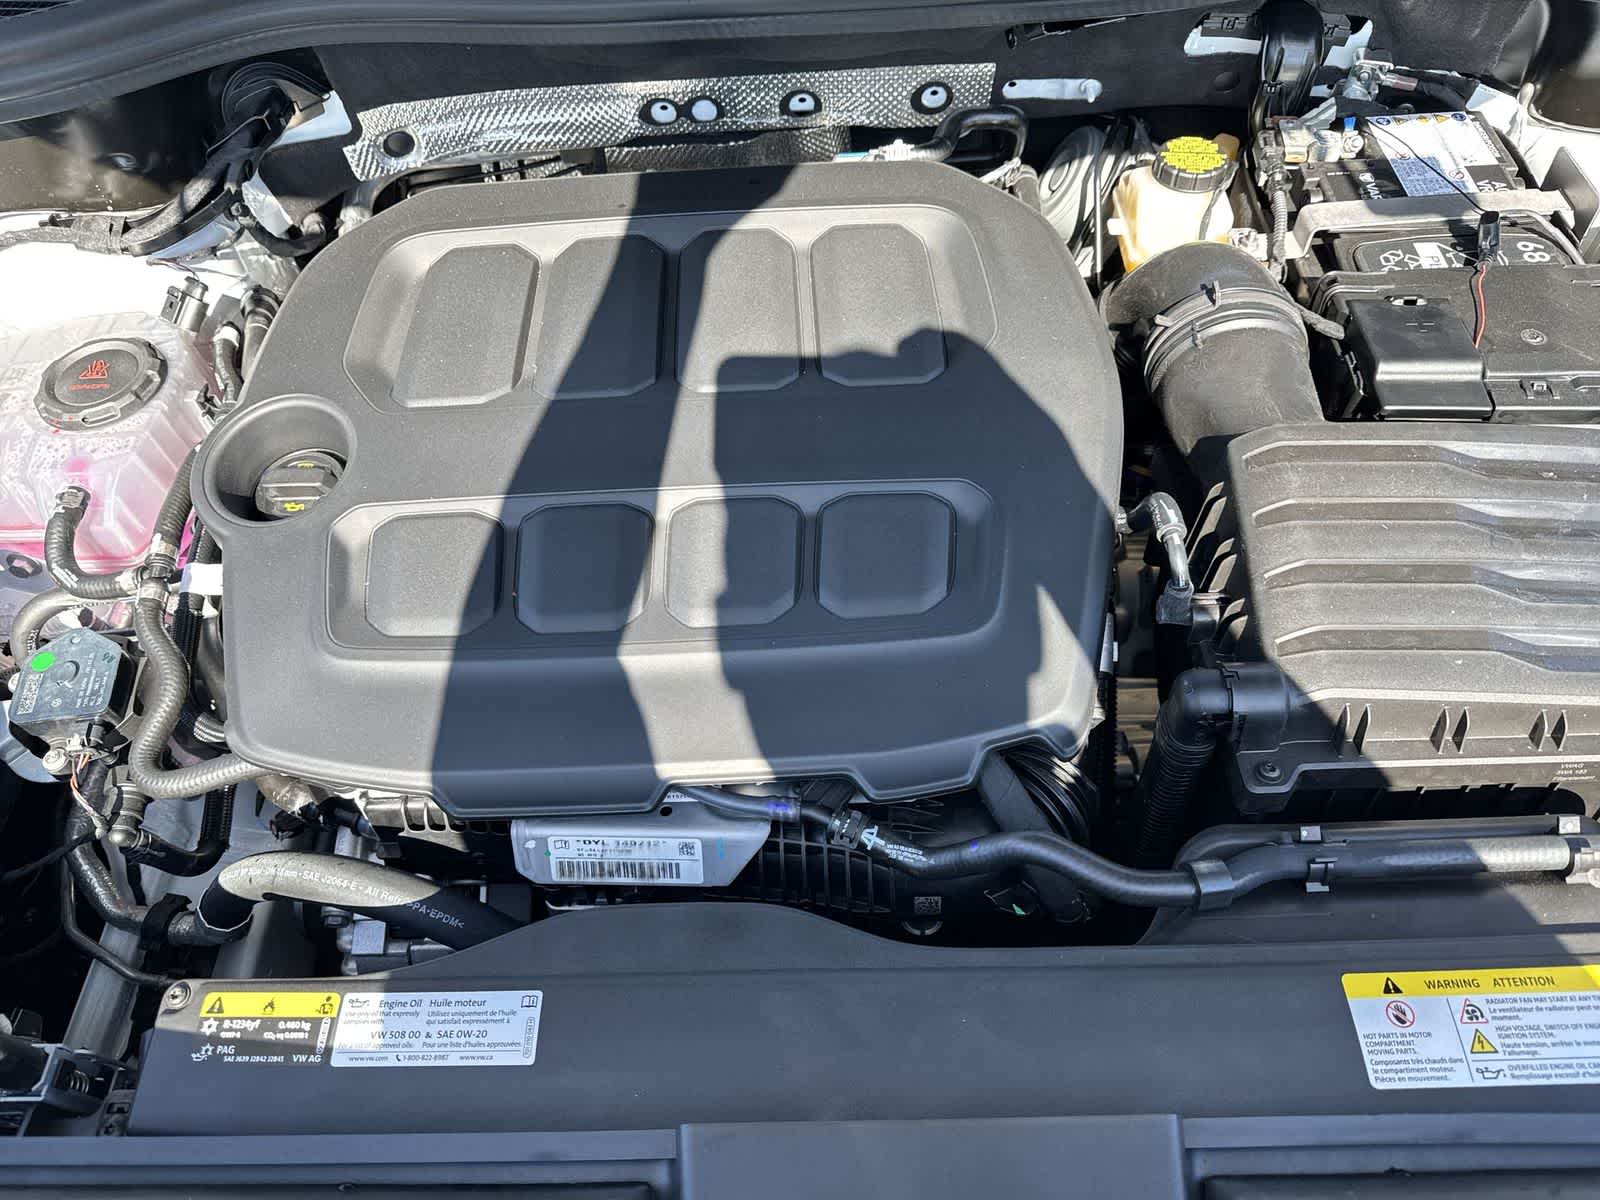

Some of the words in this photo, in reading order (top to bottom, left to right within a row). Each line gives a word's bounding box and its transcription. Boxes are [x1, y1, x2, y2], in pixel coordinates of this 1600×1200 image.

[1424, 978, 1480, 990] WARNING
[1493, 975, 1556, 988] ATTENTION
[379, 999, 408, 1010] Engine
[409, 999, 423, 1008] Oil
[430, 999, 453, 1008] Huile
[454, 999, 487, 1008] moteur
[1485, 997, 1518, 1005] RADIATOR
[1519, 996, 1533, 1004] FAN
[1547, 995, 1568, 1003] START
[1488, 1006, 1498, 1014] Le
[1499, 1005, 1534, 1013] ventilateur
[1535, 1004, 1544, 1012] de
[426, 1018, 437, 1026] qui
[370, 1030, 387, 1039] VW
[388, 1030, 406, 1040] 508
[408, 1030, 421, 1039] 00
[424, 1031, 432, 1039] &
[436, 1029, 455, 1039] SAE
[456, 1029, 488, 1039] 0W-20
[1377, 1032, 1399, 1040] PARTS
[1408, 1031, 1432, 1039] MOTOR
[422, 1041, 436, 1049] Pour
[216, 1045, 236, 1055] PAG
[1367, 1048, 1395, 1056] MOVING
[292, 1054, 308, 1063] VW
[308, 1054, 322, 1063] AG
[1370, 1058, 1411, 1067] Composants
[1411, 1057, 1424, 1065] très
[1424, 1056, 1448, 1064] chauds
[1448, 1055, 1465, 1063] dans
[1380, 1066, 1428, 1075] compartiment
[1507, 1063, 1548, 1071] OVERFILLED
[1550, 1062, 1575, 1070] ENGINE
[1375, 1075, 1397, 1083] Pièces
